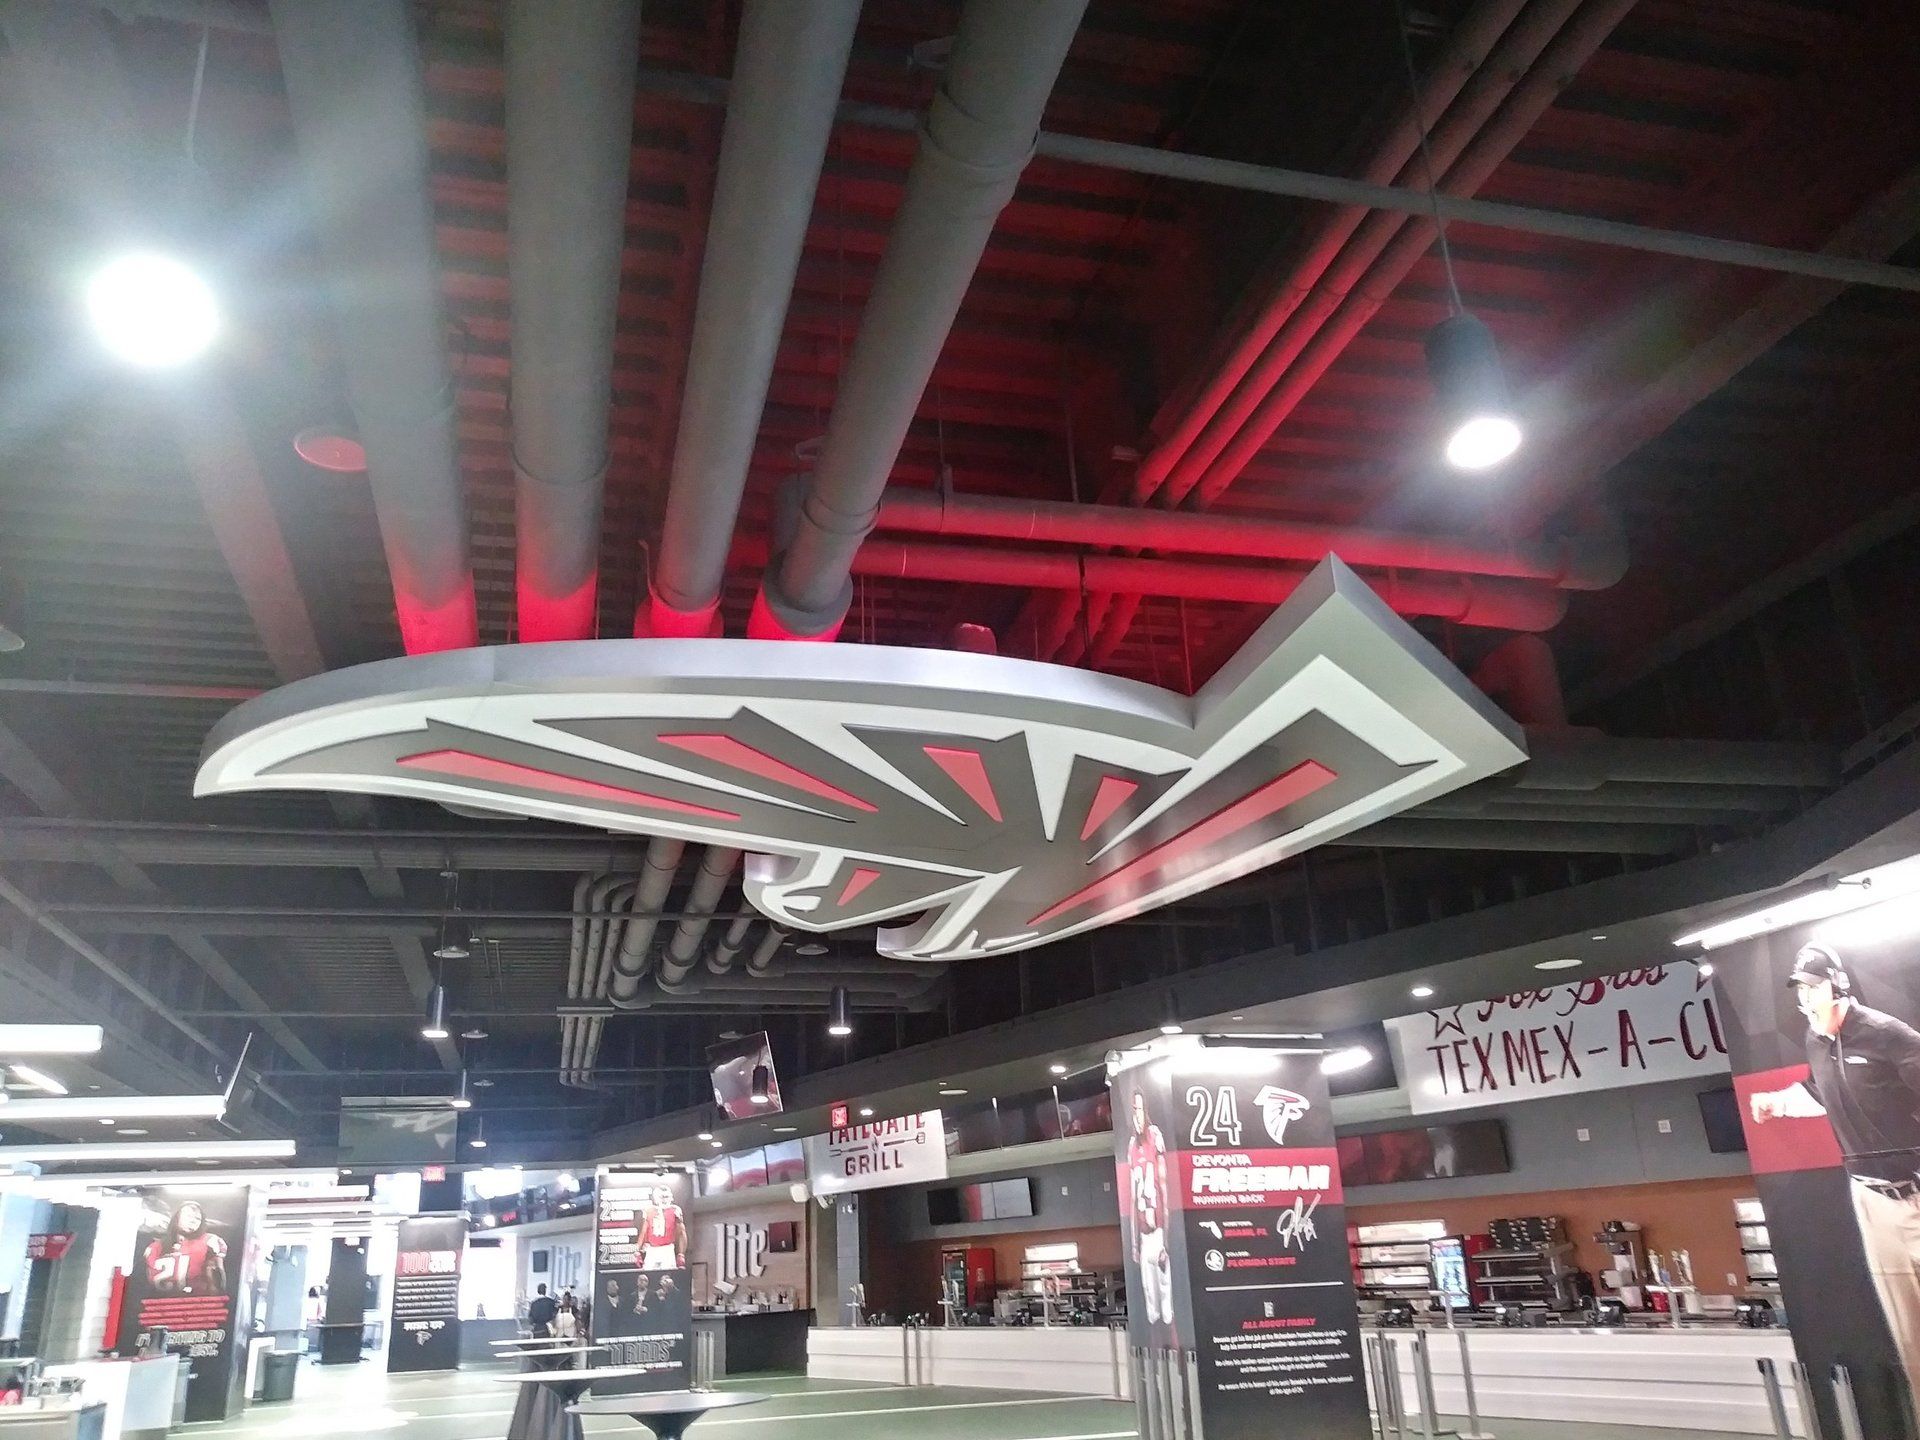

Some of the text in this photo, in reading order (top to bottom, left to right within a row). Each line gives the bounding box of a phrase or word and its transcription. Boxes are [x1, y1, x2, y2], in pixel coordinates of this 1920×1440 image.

[1186, 1085, 1242, 1146] 24
[845, 1149, 904, 1176] GRILL
[1191, 1154, 1252, 1167] DEVONTA
[1191, 1165, 1331, 1193] FREEMAN
[153, 1254, 191, 1290] 21
